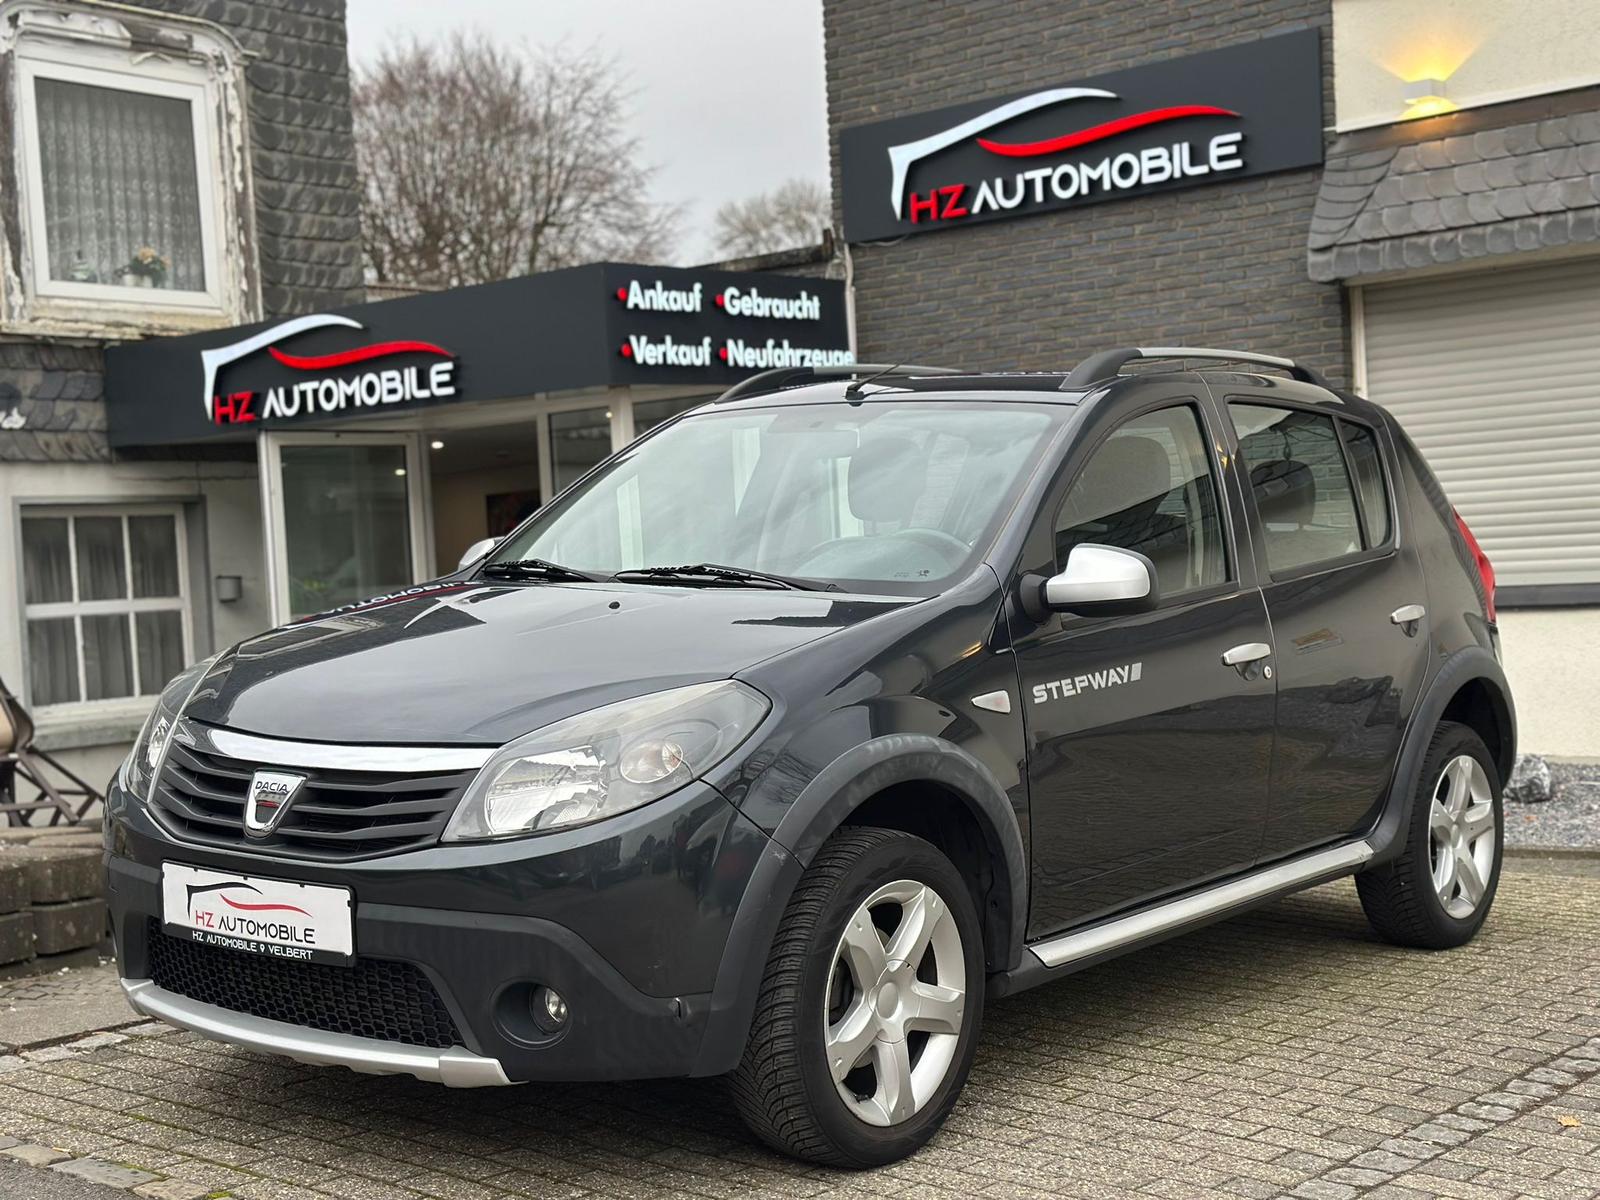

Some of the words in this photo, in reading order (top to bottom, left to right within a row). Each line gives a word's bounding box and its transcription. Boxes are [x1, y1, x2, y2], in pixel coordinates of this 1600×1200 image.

[910, 184, 969, 224] HZ
[971, 132, 1243, 215] AUTOMOBILE
[626, 280, 702, 312] Ankauf
[723, 286, 820, 320] Gebraucht
[629, 335, 711, 366] Verkauf
[214, 390, 256, 425] HZ
[262, 361, 456, 419] AUTOMOBILE
[1032, 664, 1130, 704] STEPWAY
[255, 781, 288, 793] DACIA
[192, 931, 204, 942] HZ
[206, 932, 257, 952] AUTOMOBILE
[268, 944, 313, 960] VELBERT
[195, 910, 214, 928] HZ
[218, 915, 316, 944] AUTOMOBILE
